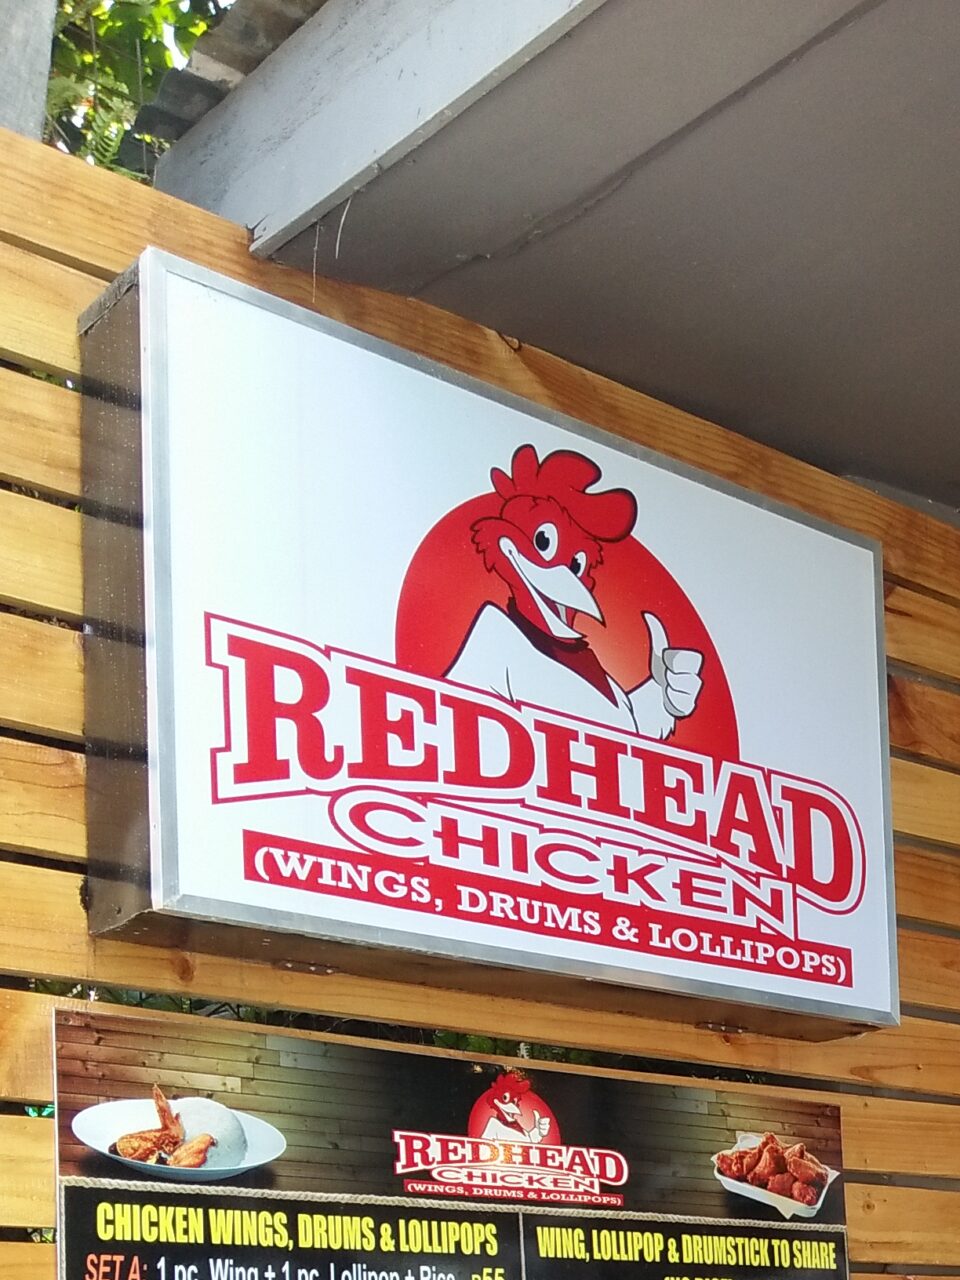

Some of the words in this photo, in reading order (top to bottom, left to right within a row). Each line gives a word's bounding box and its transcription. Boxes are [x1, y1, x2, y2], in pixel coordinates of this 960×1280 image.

[223, 634, 853, 904] REDHEAD
[348, 803, 794, 937] CHICKEN
[254, 847, 444, 912] (WINGS,
[456, 884, 602, 938] DRUMS
[613, 916, 639, 945] &
[648, 922, 847, 982] LOLLIPOPS)
[399, 1133, 626, 1184] REDHEAD
[433, 1168, 599, 1192] CHICKEN
[407, 1183, 468, 1196] (WINGS,
[473, 1187, 525, 1199] DRUMS
[528, 1191, 538, 1200] &
[540, 1192, 622, 1205] LOLLIPOPS)
[96, 1202, 204, 1244] CHICKEN
[208, 1208, 294, 1251] WINGS,
[298, 1216, 375, 1252] DRUMS
[380, 1225, 394, 1251] &
[399, 1219, 498, 1256] LOLLIPOPS
[537, 1227, 589, 1263] WING,
[593, 1230, 664, 1263] LOLLIPOP
[669, 1237, 679, 1263] &
[682, 1234, 770, 1267] DRUMSTICK
[771, 1239, 790, 1269] TO
[793, 1240, 836, 1269] SHARE
